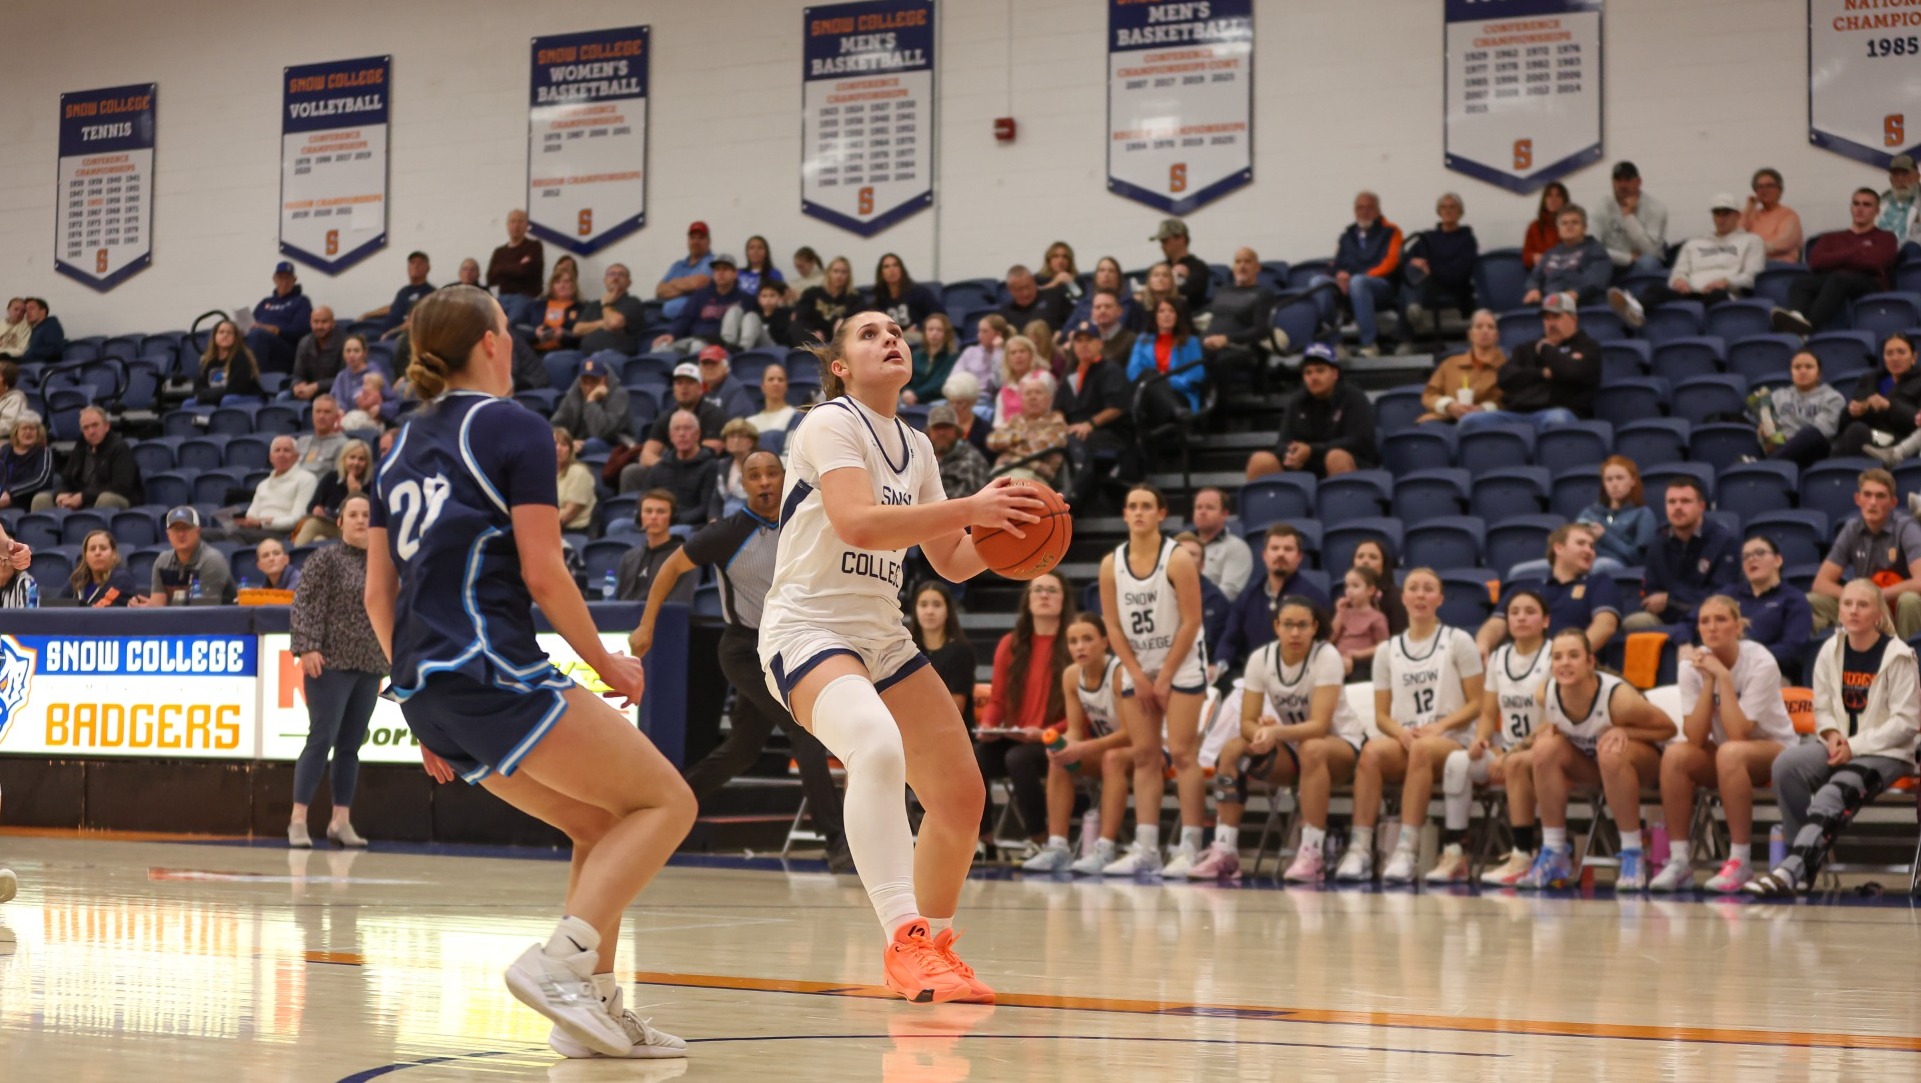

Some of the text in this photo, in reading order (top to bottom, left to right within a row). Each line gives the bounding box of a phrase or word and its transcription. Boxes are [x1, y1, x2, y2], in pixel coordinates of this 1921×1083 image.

[812, 10, 926, 36] SNOW COLLEGE
[1148, 2, 1210, 22] MEN'S
[538, 40, 642, 64] SNOW COLLEGE
[840, 33, 896, 53] MEN'S
[1867, 37, 1920, 58] 1985
[550, 60, 628, 82] WOMEN'S
[811, 49, 926, 76] BASKETBALL
[290, 68, 384, 93] SNOW COLLEGE
[537, 78, 641, 102] BASKETBALL
[66, 96, 150, 118] SNOW COLLEGE
[289, 94, 382, 118] VOLLEYBALL
[82, 122, 132, 141] TENNIS
[1125, 590, 1158, 606] SNOW
[1130, 609, 1154, 634] 25
[46, 640, 244, 672] SNOW COLLEGE
[1402, 669, 1438, 687] SNOW
[1414, 688, 1434, 714] 12
[45, 703, 240, 750] BADGERS
[1510, 713, 1530, 738] 21
